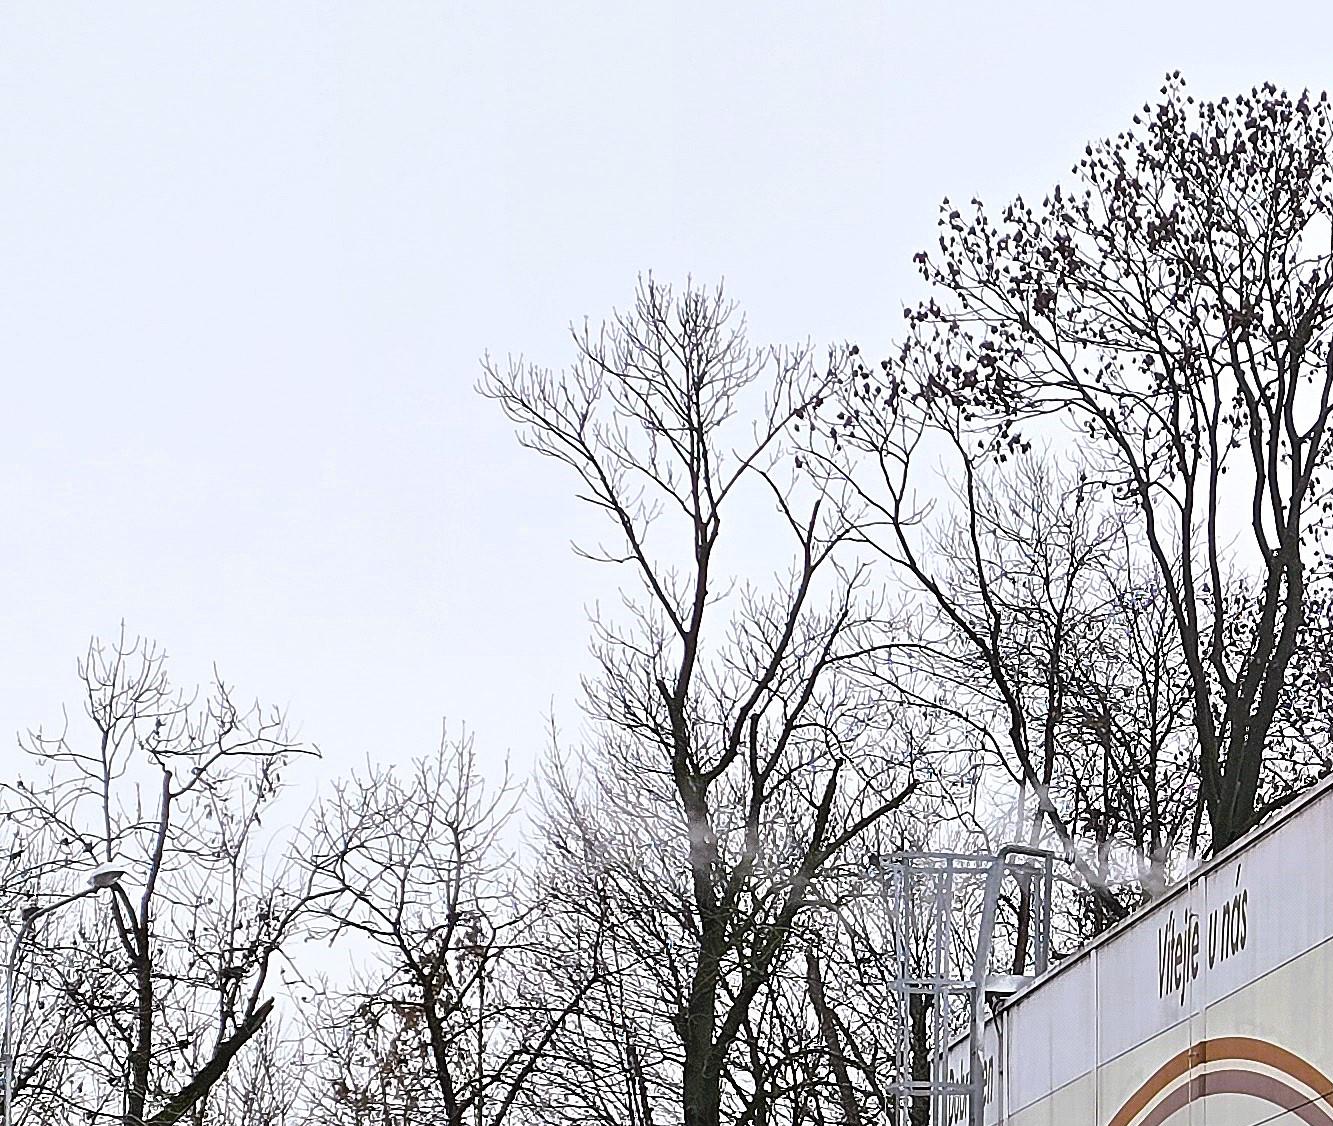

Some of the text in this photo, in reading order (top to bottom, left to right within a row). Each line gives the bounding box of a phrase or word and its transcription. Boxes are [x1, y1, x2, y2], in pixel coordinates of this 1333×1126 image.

[1158, 863, 1248, 1007] Vítejte u nás
